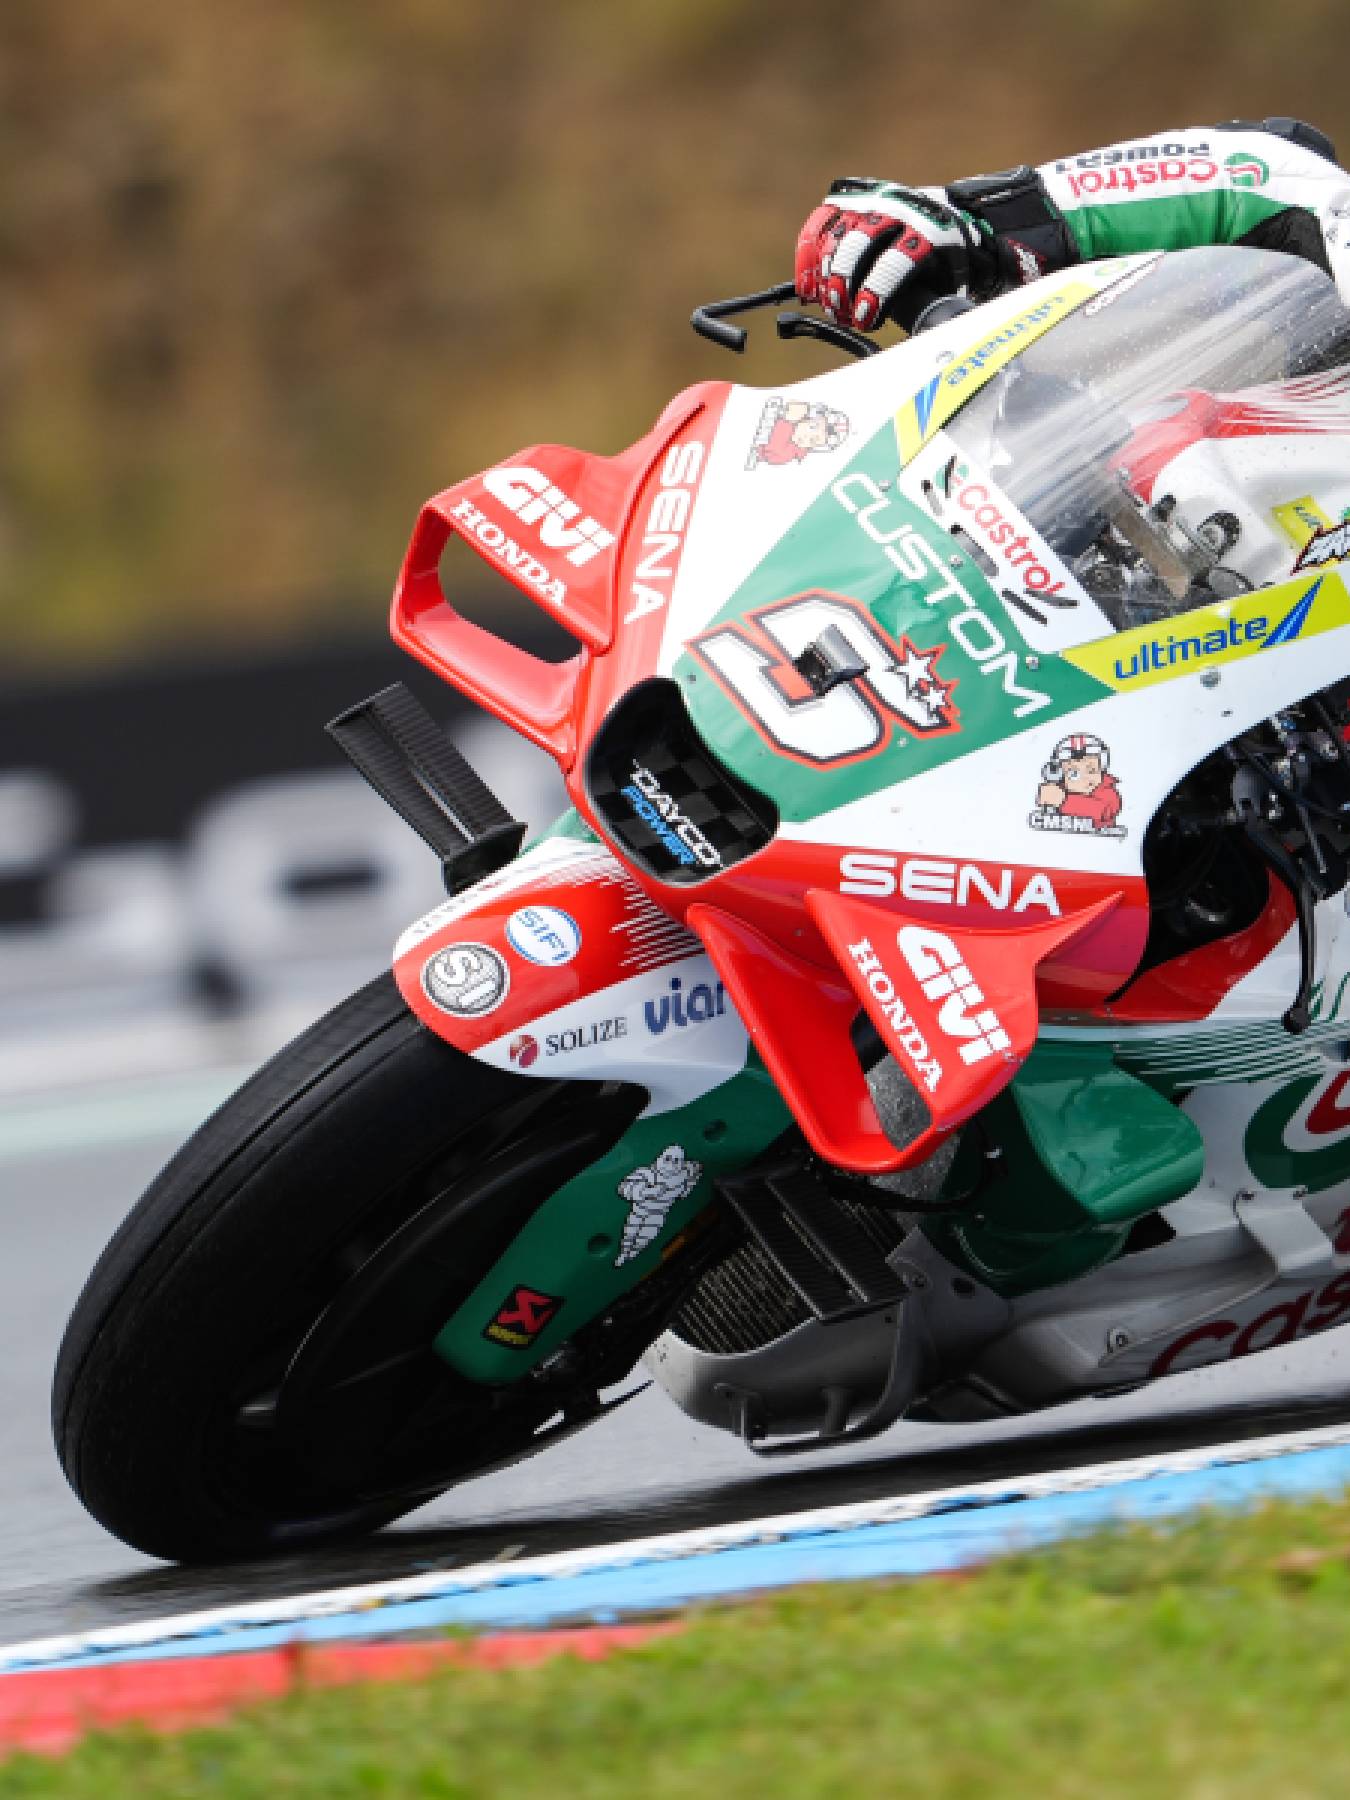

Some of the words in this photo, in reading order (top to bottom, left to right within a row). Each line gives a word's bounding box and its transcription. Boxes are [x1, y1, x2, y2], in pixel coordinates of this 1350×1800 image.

[1067, 158, 1219, 198] Castrol
[450, 498, 567, 607] HONDA
[622, 441, 704, 624] SENA
[956, 484, 1066, 599] Castrol
[830, 473, 1053, 718] CUSTOM
[1114, 613, 1270, 681] ultimate
[620, 785, 697, 865] POWER
[630, 767, 721, 865] DAYCO
[839, 853, 1063, 918] SENA
[514, 908, 571, 962] SIFI
[545, 1016, 629, 1057] SOLIZE
[848, 939, 943, 1093] HONDA
